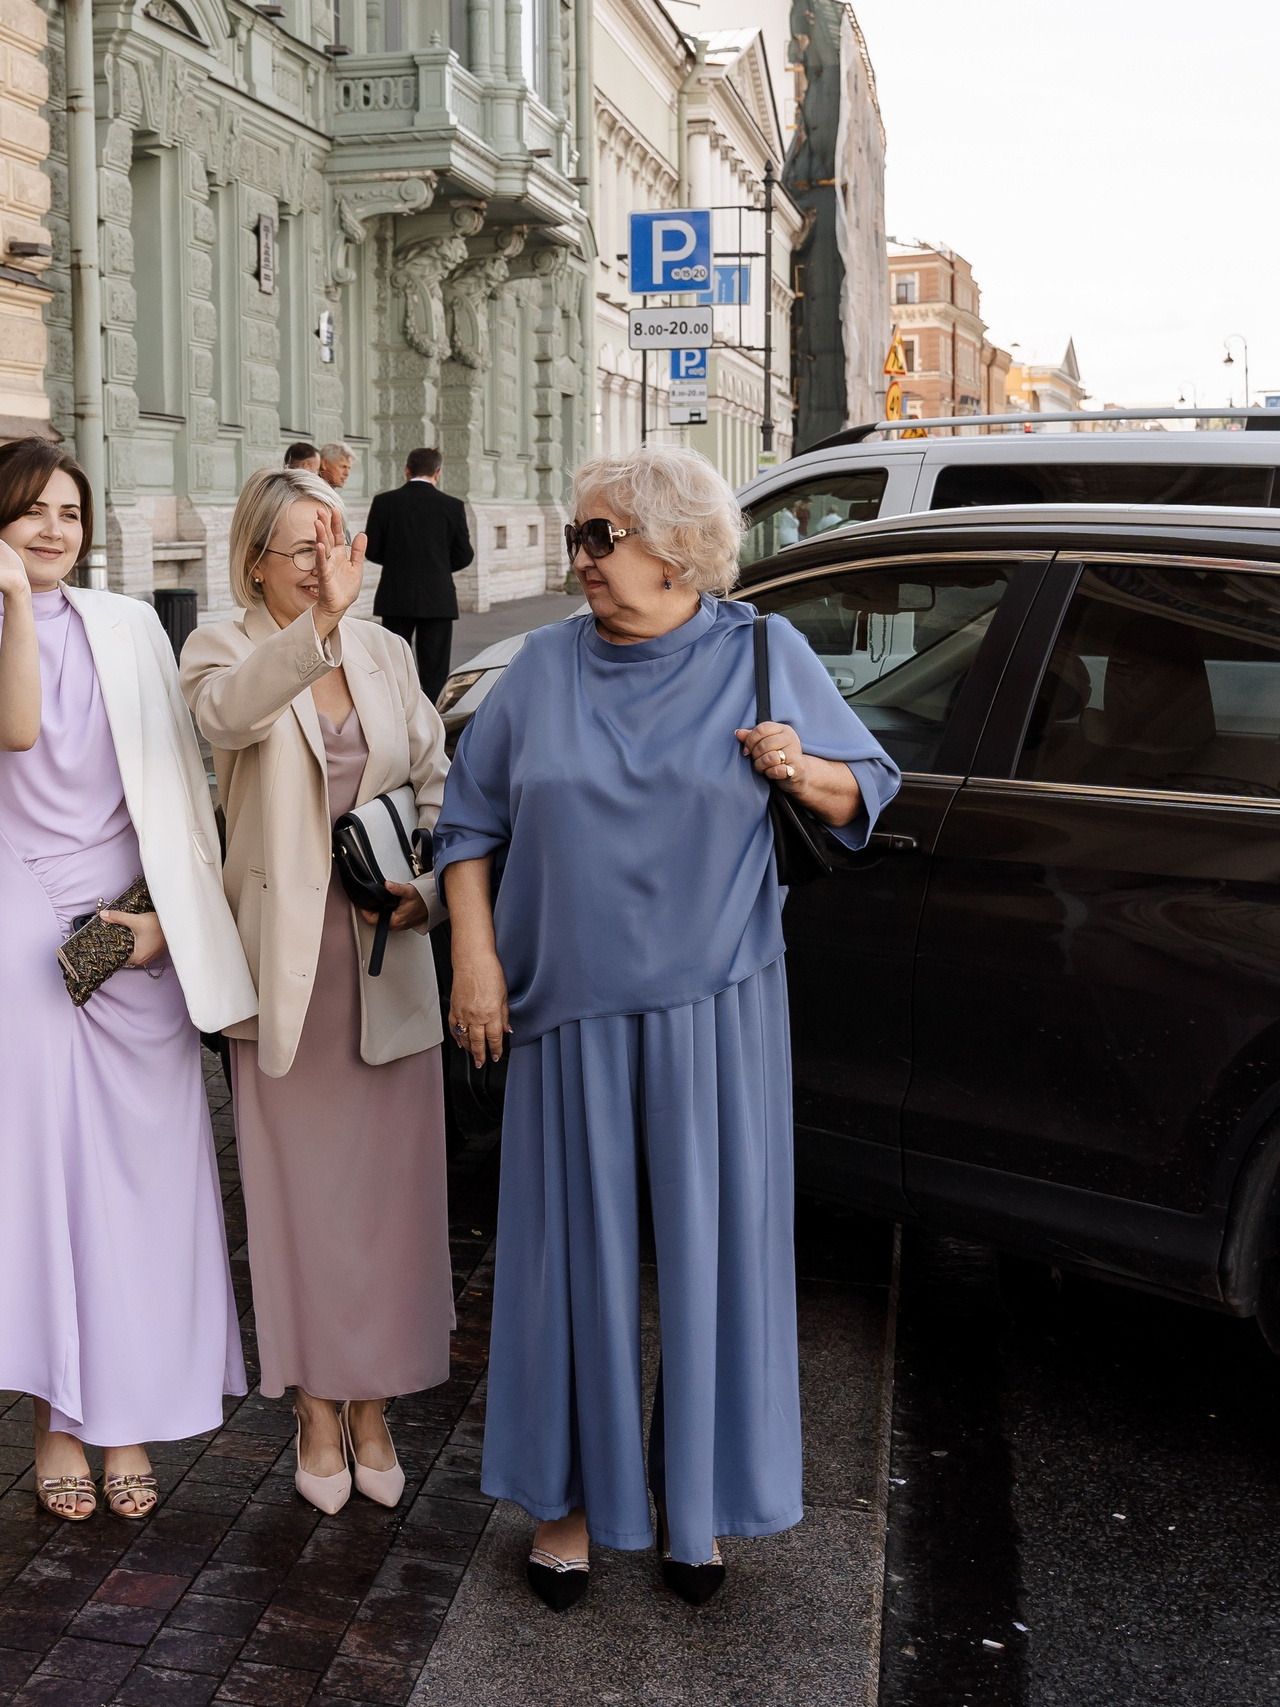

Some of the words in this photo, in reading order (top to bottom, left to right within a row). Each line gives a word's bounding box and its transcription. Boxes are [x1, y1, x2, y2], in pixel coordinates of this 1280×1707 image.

[652, 219, 697, 285] P
[682, 269, 691, 277] 15
[694, 268, 706, 278] 20
[634, 321, 709, 337] 8.00-20.00
[679, 349, 702, 377] P
